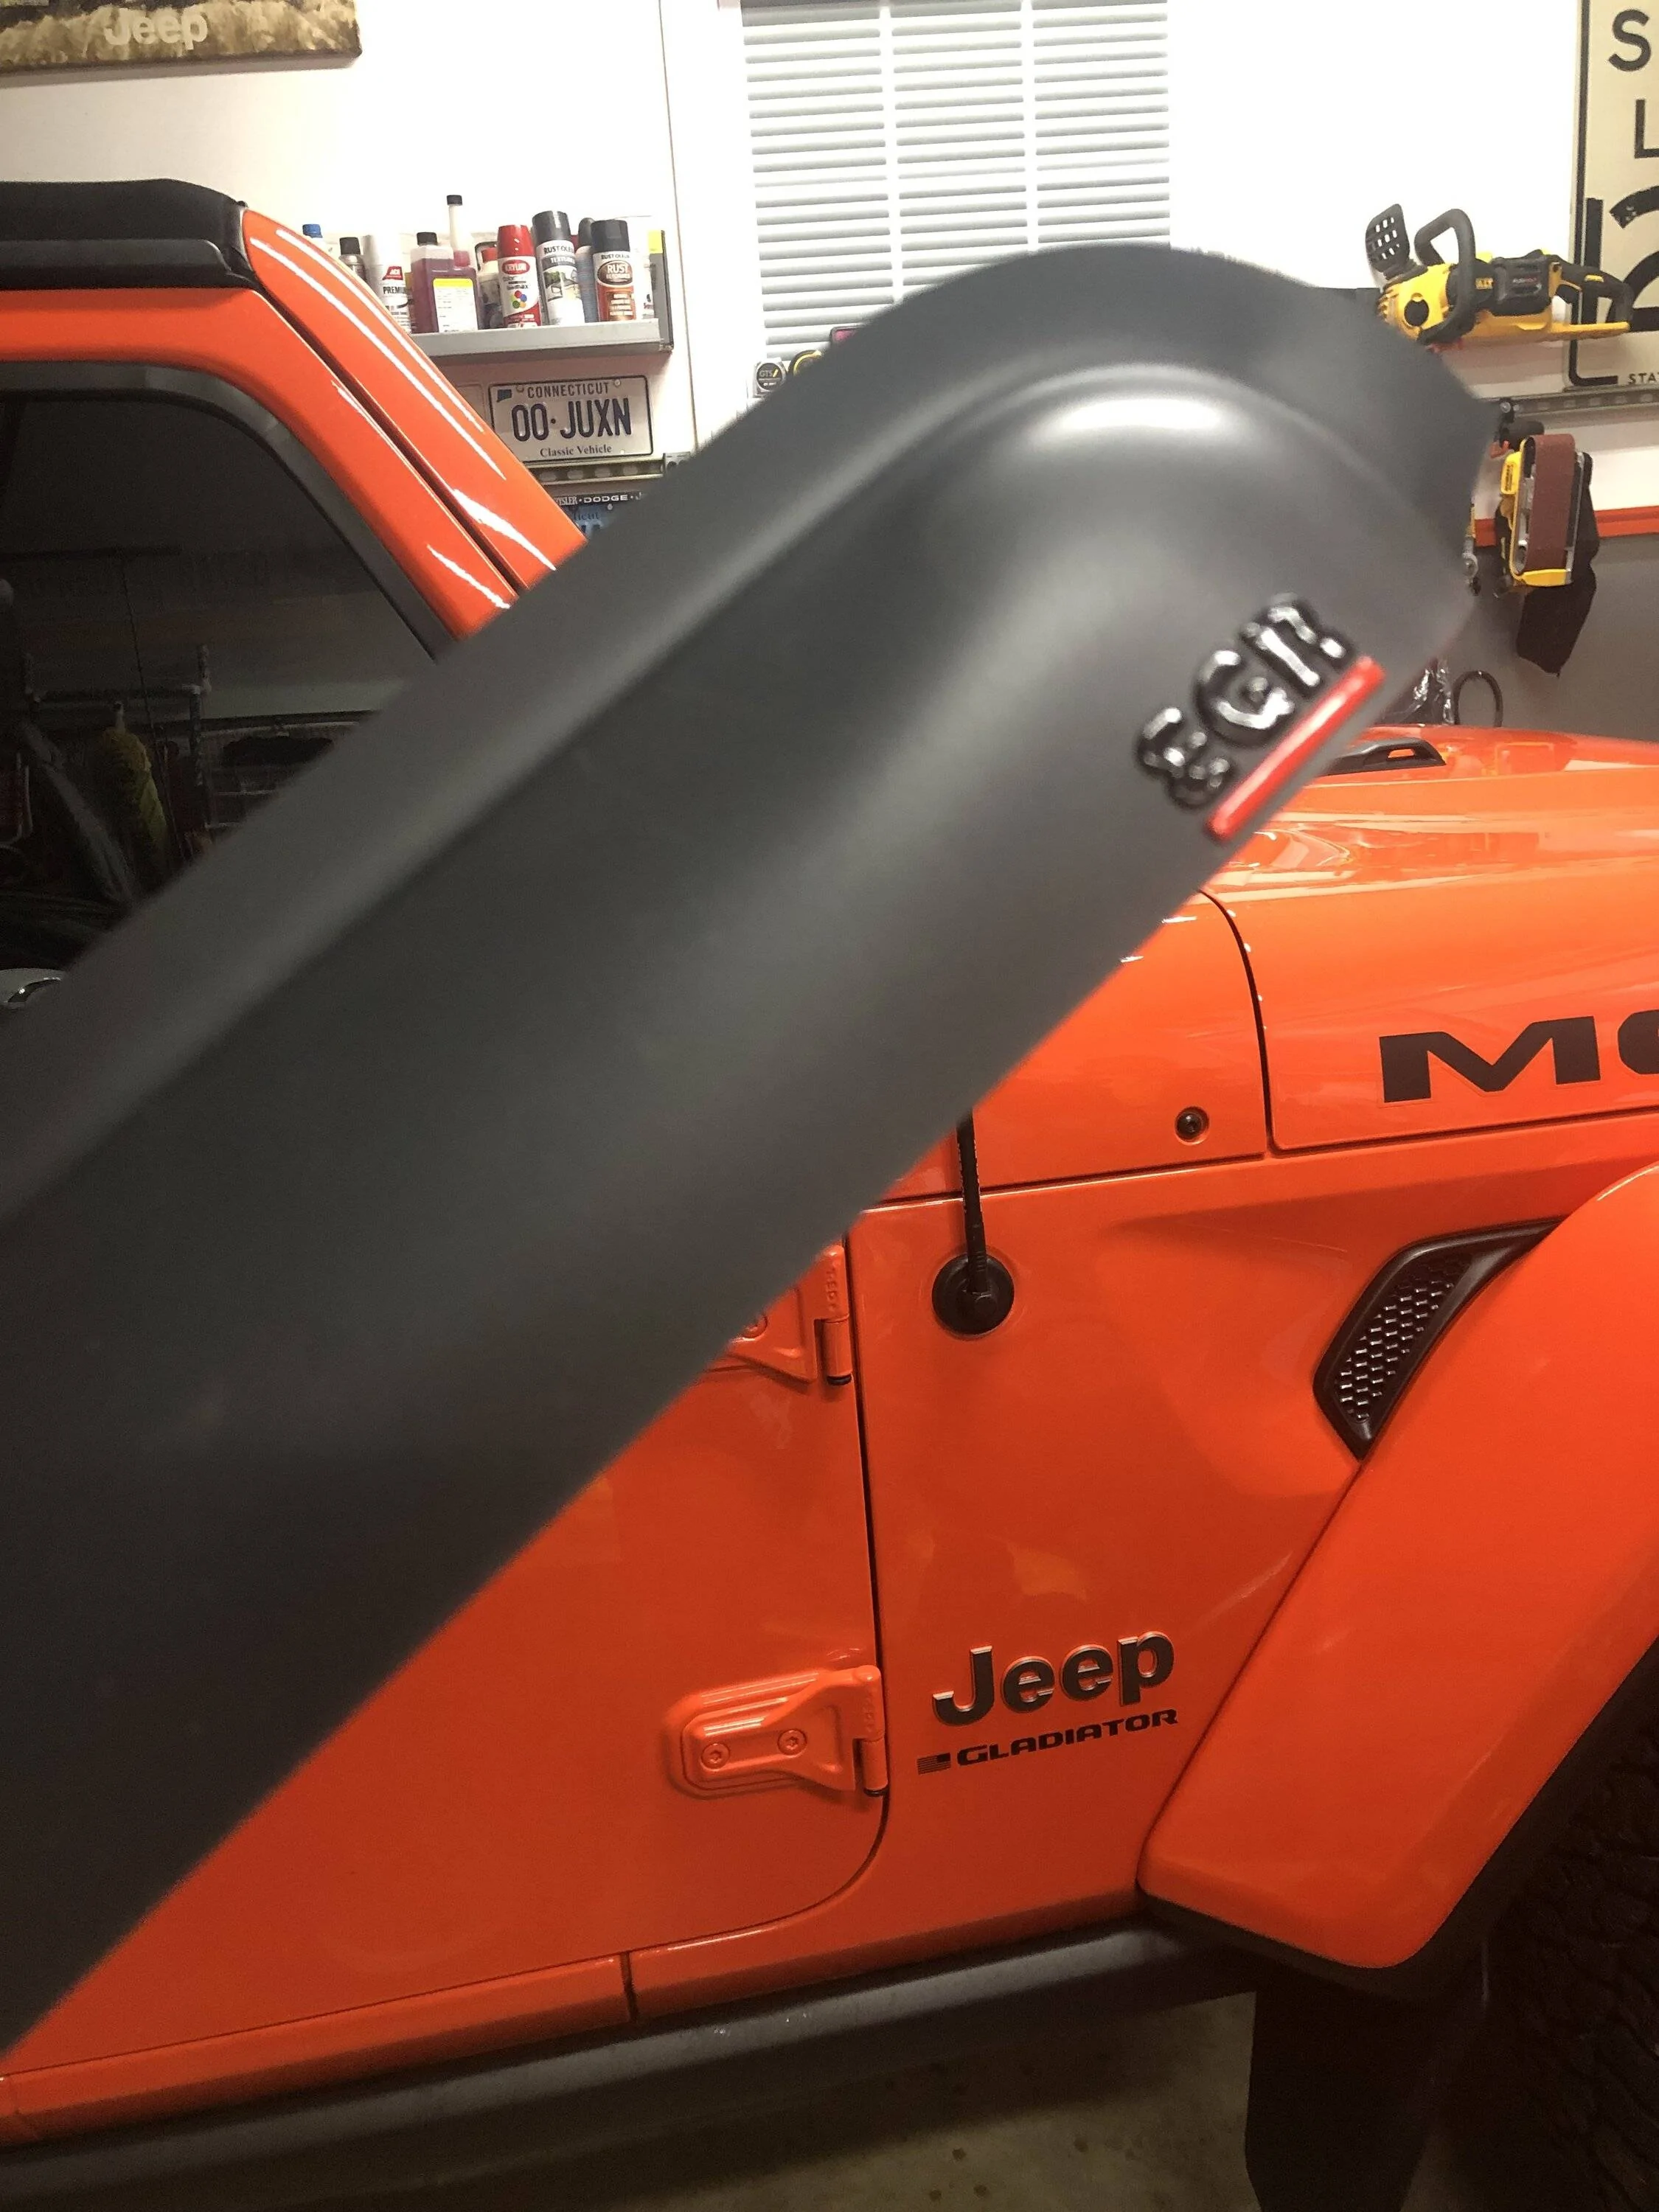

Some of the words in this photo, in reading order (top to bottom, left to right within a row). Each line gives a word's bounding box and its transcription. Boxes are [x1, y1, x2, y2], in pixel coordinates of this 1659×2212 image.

[102, 7, 208, 49] Jeep
[607, 264, 629, 274] RUST
[1628, 372, 1659, 384] STA
[527, 382, 611, 399] CONNECTICUT
[540, 445, 574, 457] Classic
[577, 444, 612, 455] Vehicle
[583, 494, 628, 503] DODGE
[932, 1630, 1175, 1727] Jeep
[957, 1708, 1178, 1767] GLADIATOR
